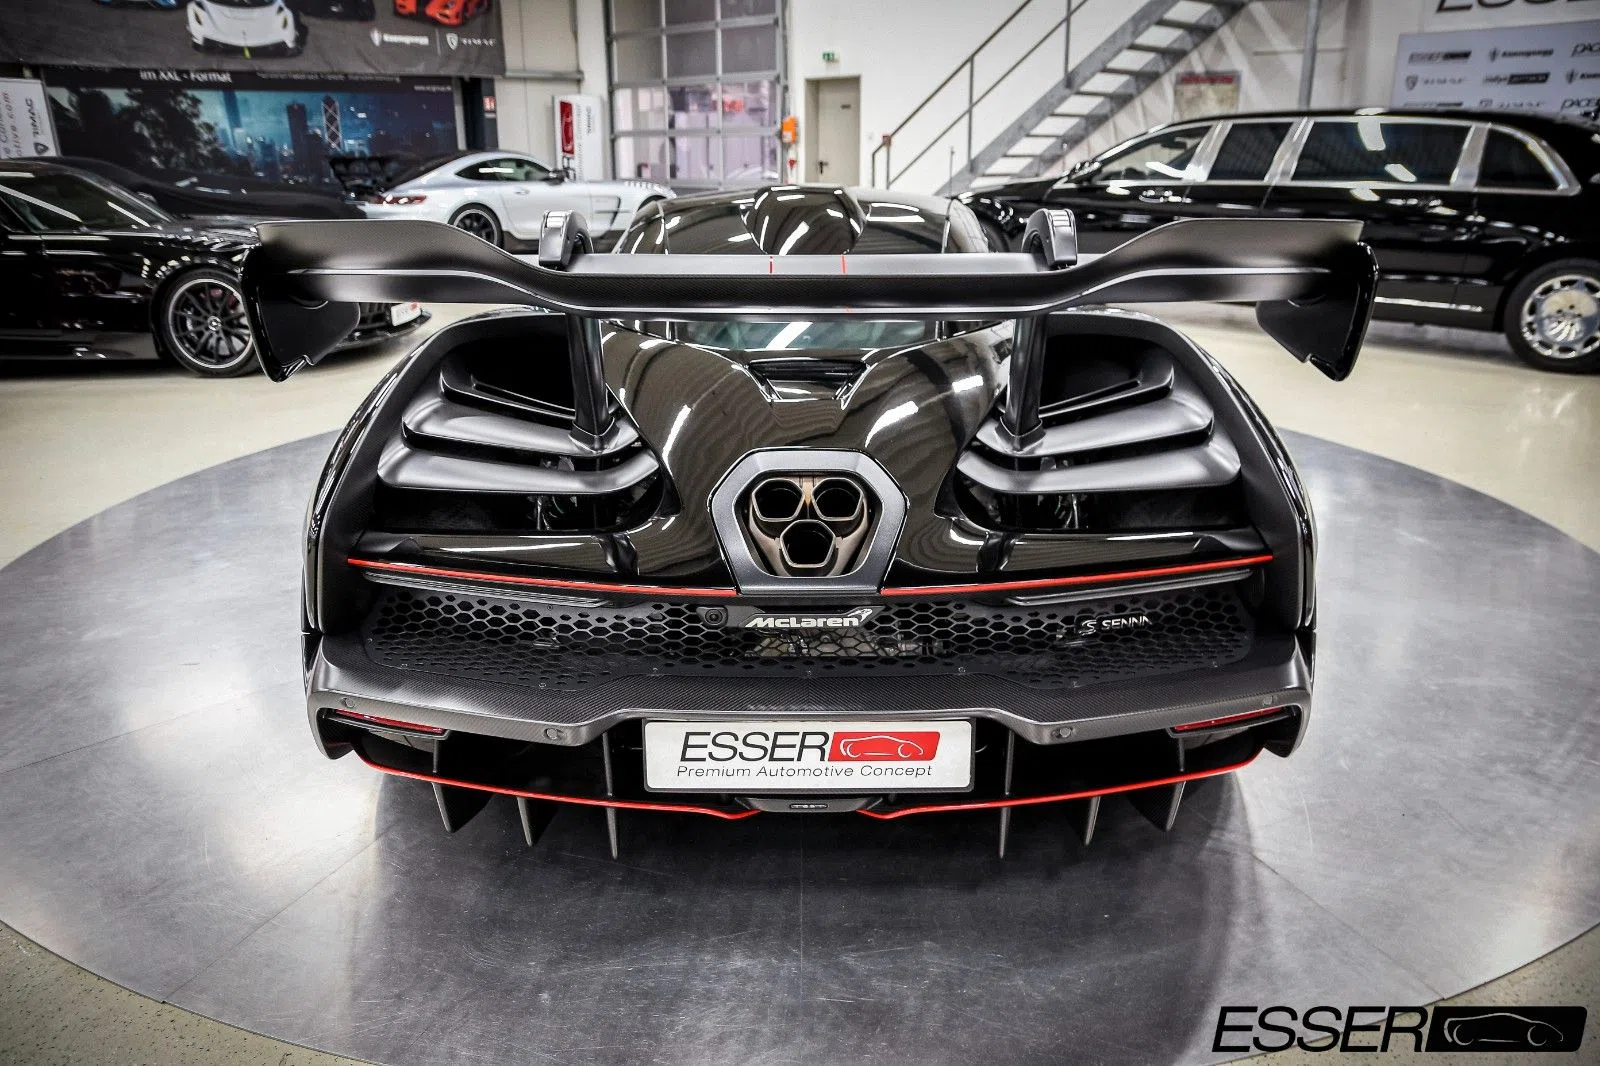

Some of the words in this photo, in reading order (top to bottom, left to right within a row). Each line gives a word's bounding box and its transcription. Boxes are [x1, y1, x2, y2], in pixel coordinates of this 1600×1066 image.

[745, 617, 859, 628] McLaren
[1101, 615, 1153, 631] SENNA
[680, 731, 830, 762] ESSER
[676, 765, 751, 777] Premium
[756, 765, 854, 777] Automotive
[860, 765, 933, 780] Concept
